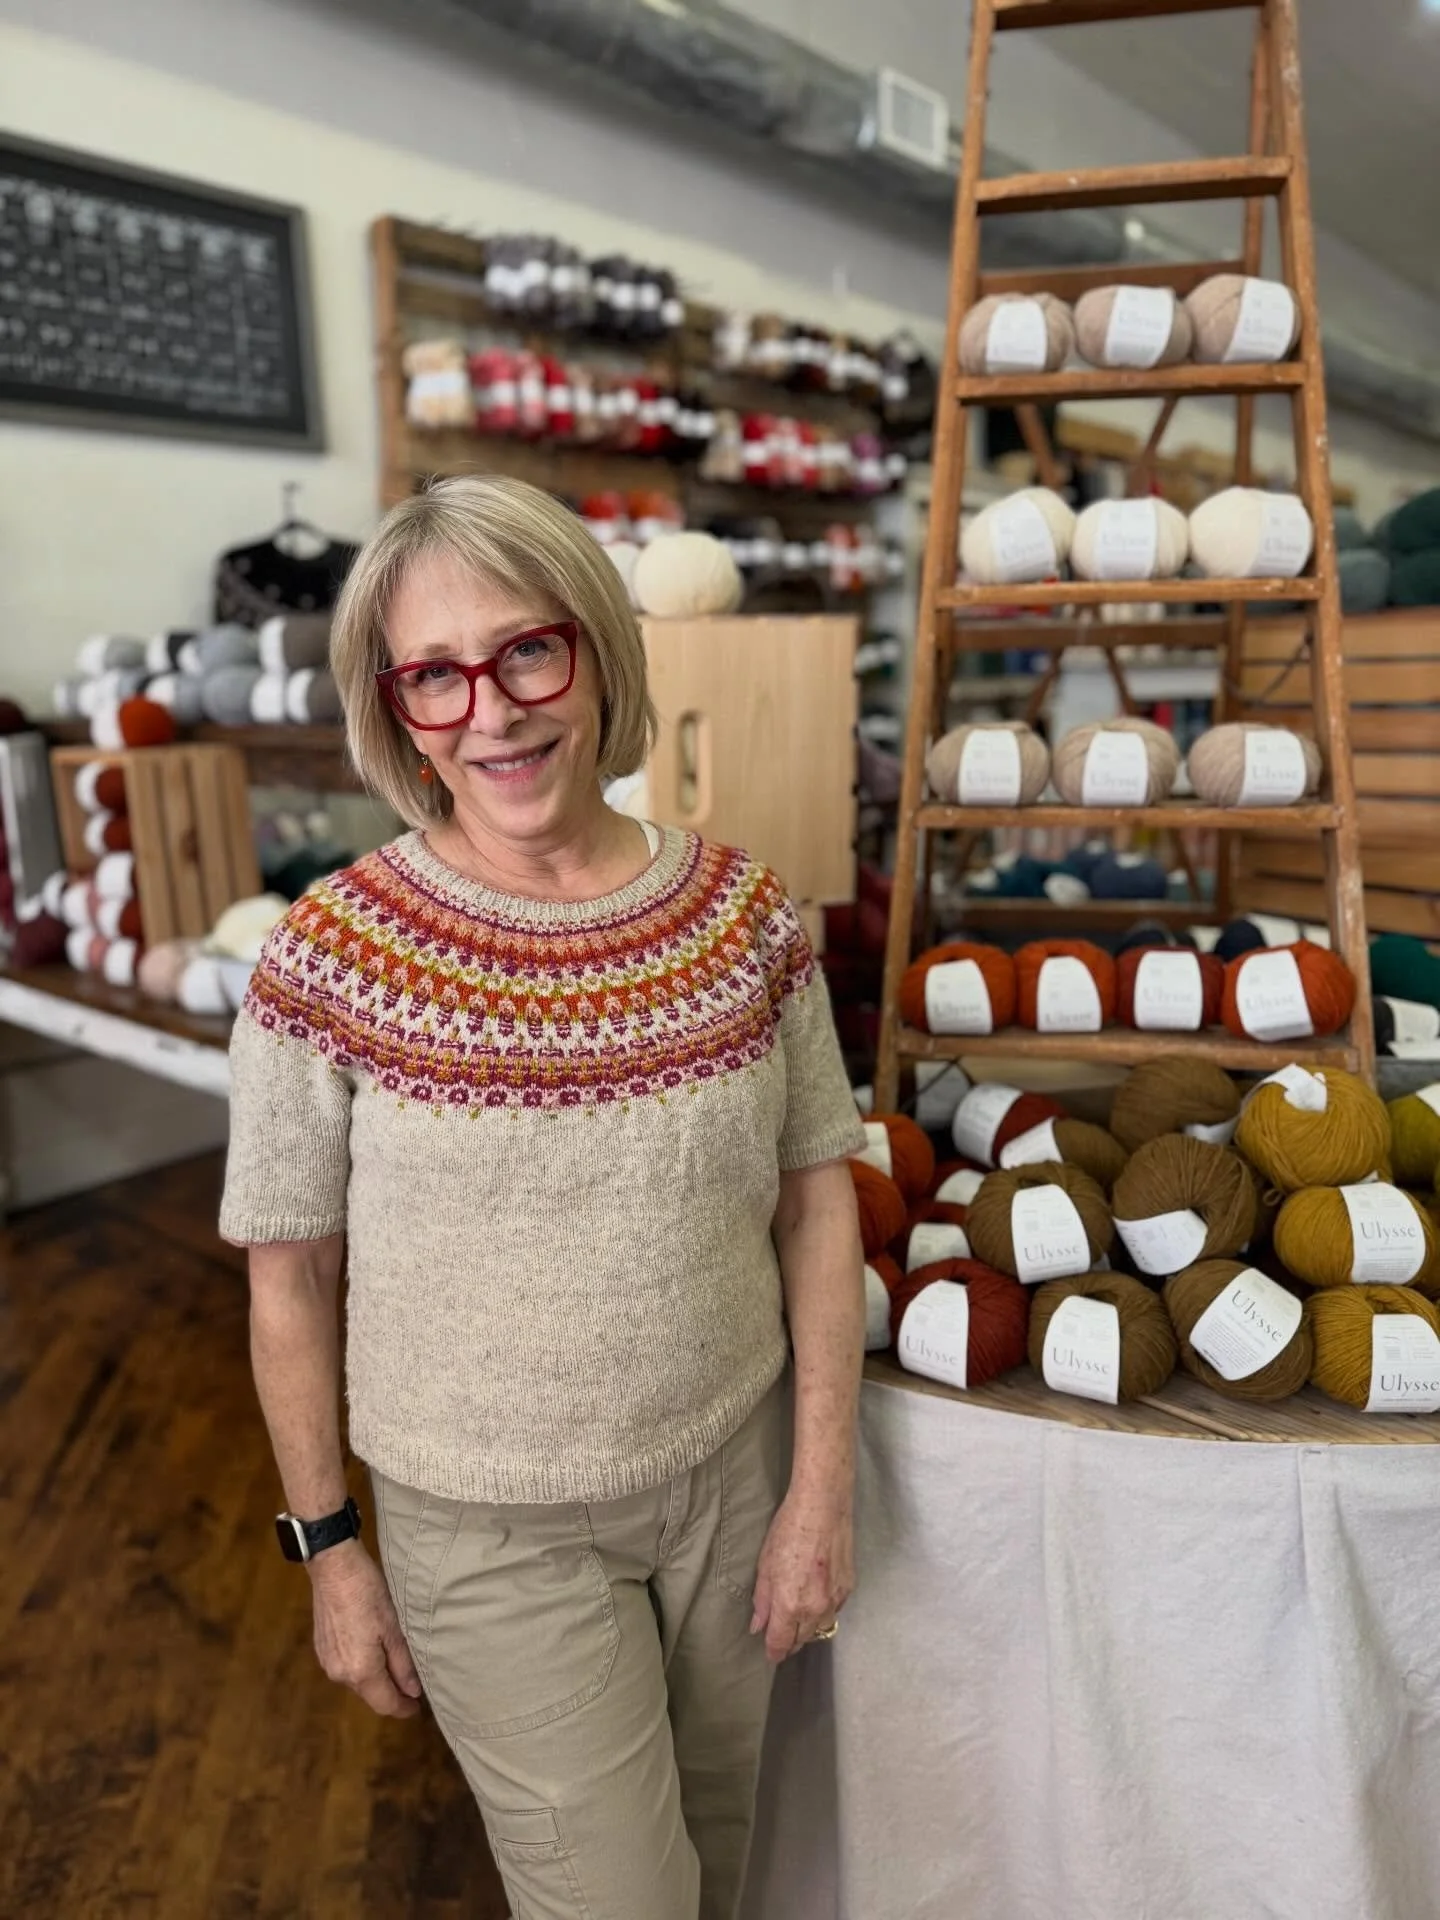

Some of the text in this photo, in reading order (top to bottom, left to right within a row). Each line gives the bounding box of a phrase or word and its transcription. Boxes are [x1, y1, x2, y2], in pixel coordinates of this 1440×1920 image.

[1360, 1221, 1418, 1245] Ulysse
[1024, 1243, 1082, 1264] Ulysse
[1231, 1289, 1284, 1343] Ulysse
[905, 1335, 959, 1366] Ulysse
[1052, 1347, 1111, 1375] Ulysse
[1380, 1373, 1440, 1397] Ulysse
